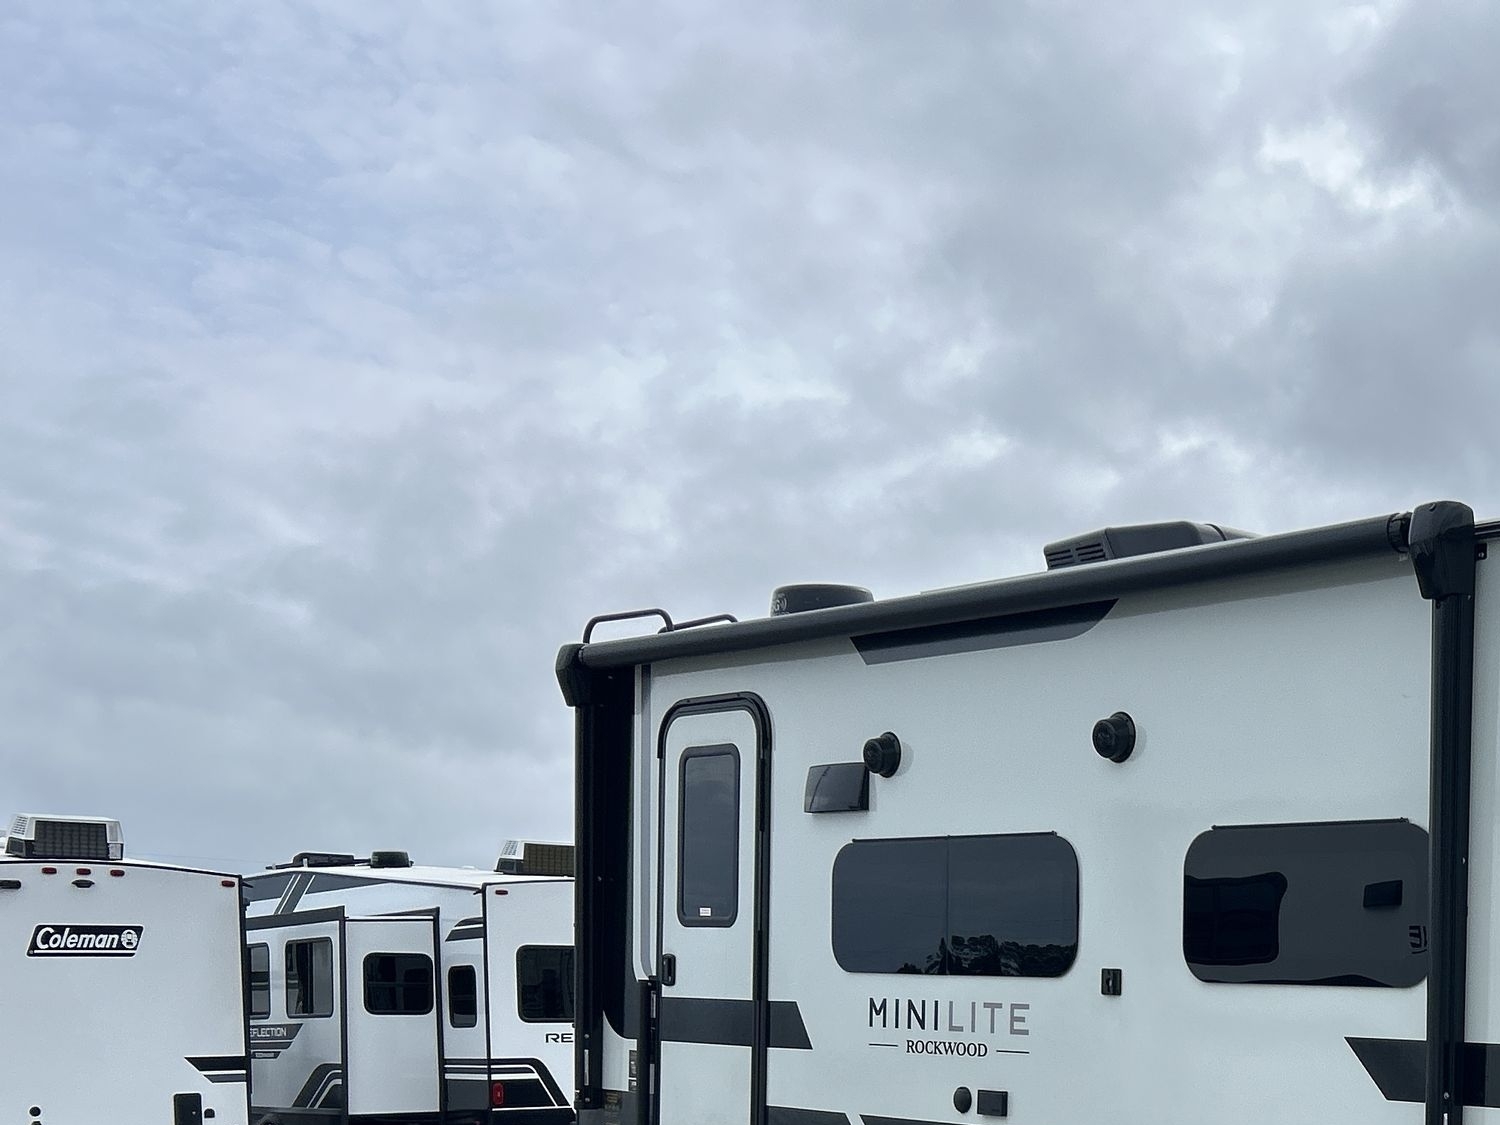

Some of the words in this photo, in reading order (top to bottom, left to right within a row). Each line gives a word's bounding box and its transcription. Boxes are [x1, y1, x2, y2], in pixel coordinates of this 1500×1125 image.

[36, 926, 120, 950] Coleman
[868, 997, 1030, 1036] MINILITE
[905, 1039, 988, 1058] ROCKWOOD
